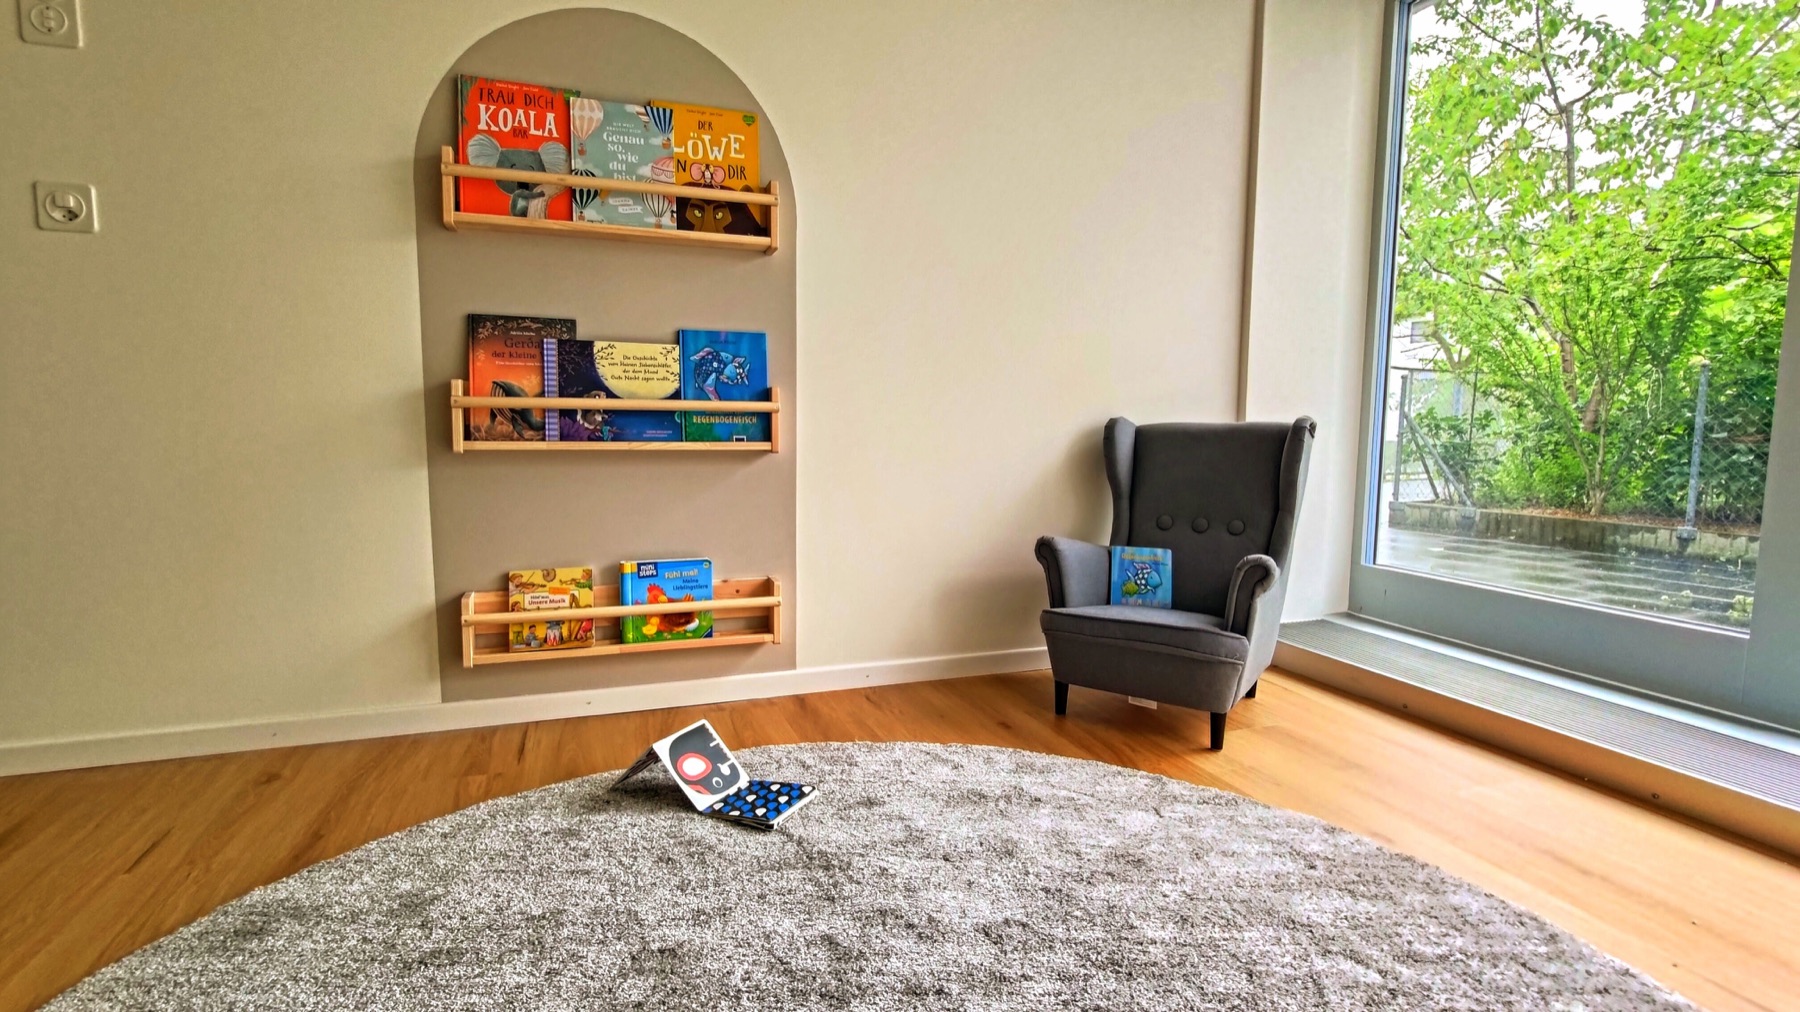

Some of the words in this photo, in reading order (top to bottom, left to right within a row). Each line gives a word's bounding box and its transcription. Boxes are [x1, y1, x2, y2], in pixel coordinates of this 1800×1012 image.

[523, 93, 554, 110] DICH
[478, 103, 559, 137] KOALA
[697, 120, 714, 132] DER
[603, 132, 644, 144] Genau
[618, 152, 638, 163] wie
[609, 161, 626, 171] du
[727, 164, 748, 181] DIR
[491, 350, 506, 359] der
[693, 415, 758, 424] REGENBOGENFISCH
[640, 569, 657, 577] steps
